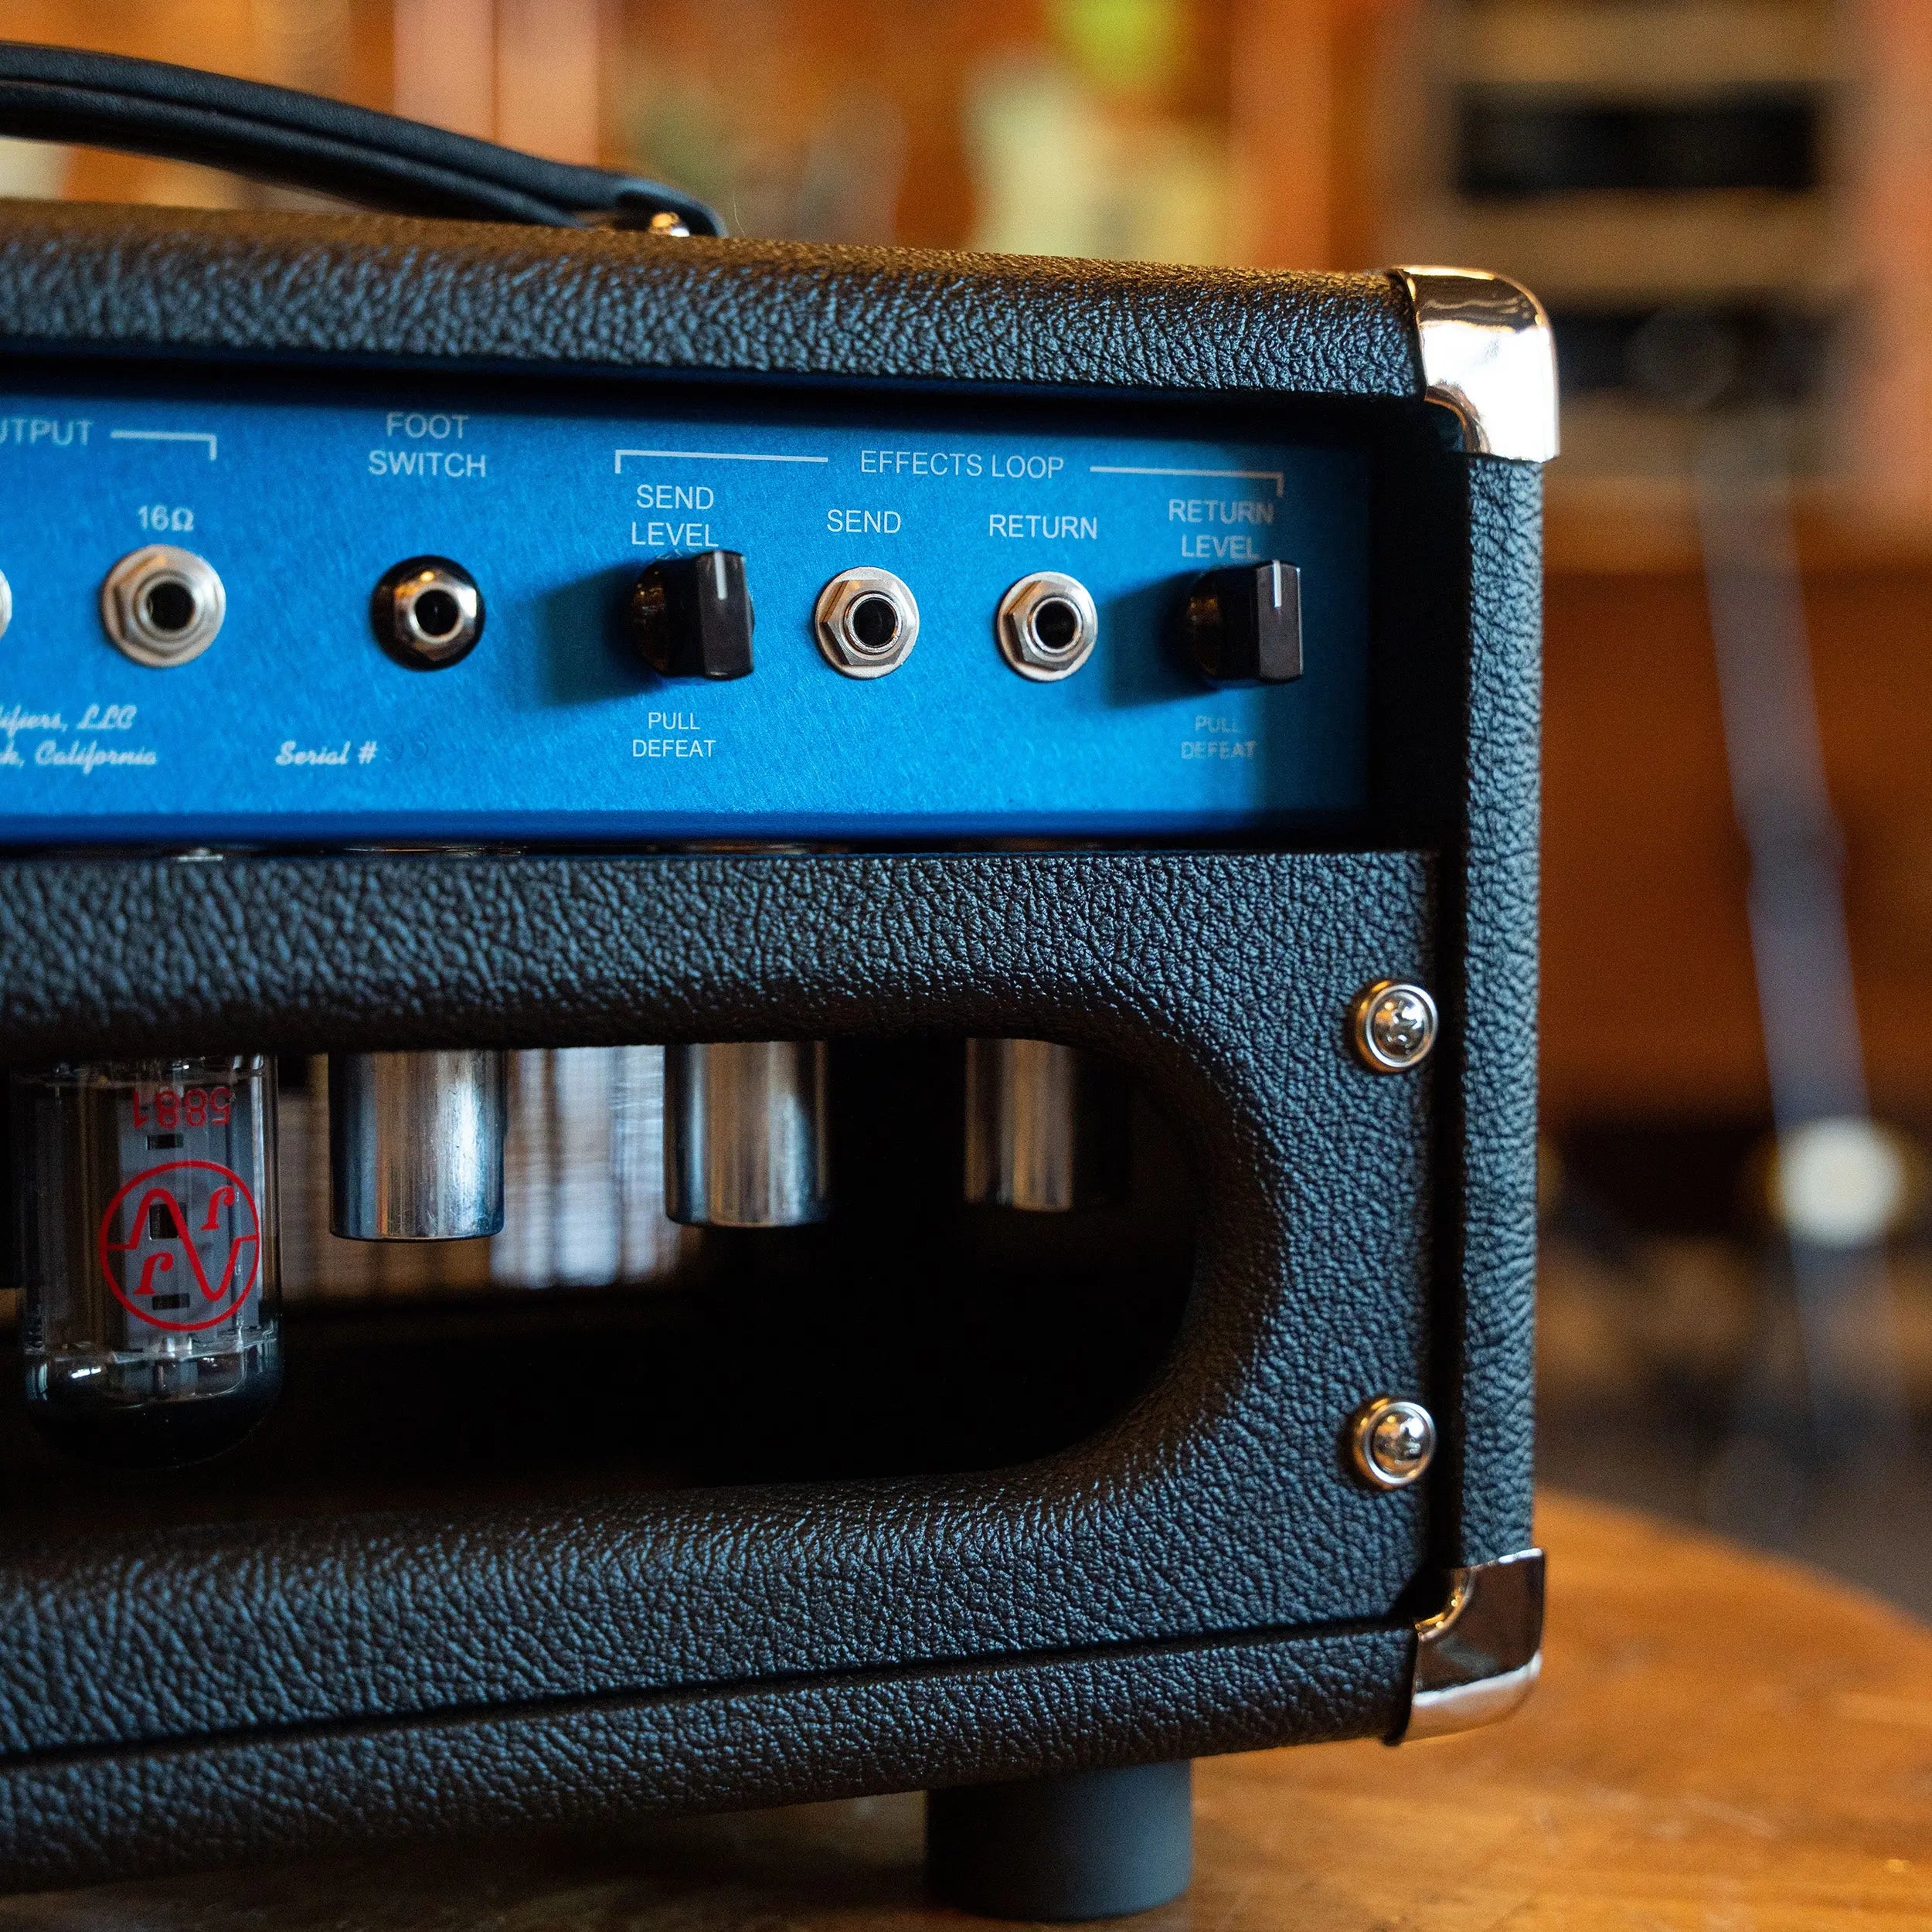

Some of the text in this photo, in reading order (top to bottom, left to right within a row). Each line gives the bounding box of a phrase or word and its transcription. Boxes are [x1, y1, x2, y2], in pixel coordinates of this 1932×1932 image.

[386, 411, 469, 439] FOOT
[369, 450, 486, 478] SWITCH
[860, 450, 1064, 479] EFFECTS LOOP
[636, 484, 714, 510] SEND
[138, 505, 194, 532] 16Ω
[826, 509, 901, 534] SEND
[1168, 498, 1274, 526] RETURN
[631, 522, 719, 547] LEVEL
[989, 513, 1097, 540] RETURN
[1181, 533, 1261, 561] LEVEL
[77, 703, 137, 730] LLC
[648, 712, 700, 730] PULL
[1195, 715, 1238, 733] PULL
[35, 740, 157, 774] California
[275, 740, 350, 765] Serial
[358, 740, 378, 764] #
[632, 740, 716, 758] DEFEAT
[1180, 740, 1257, 760] DEFEAT
[133, 1087, 233, 1129] 5881
